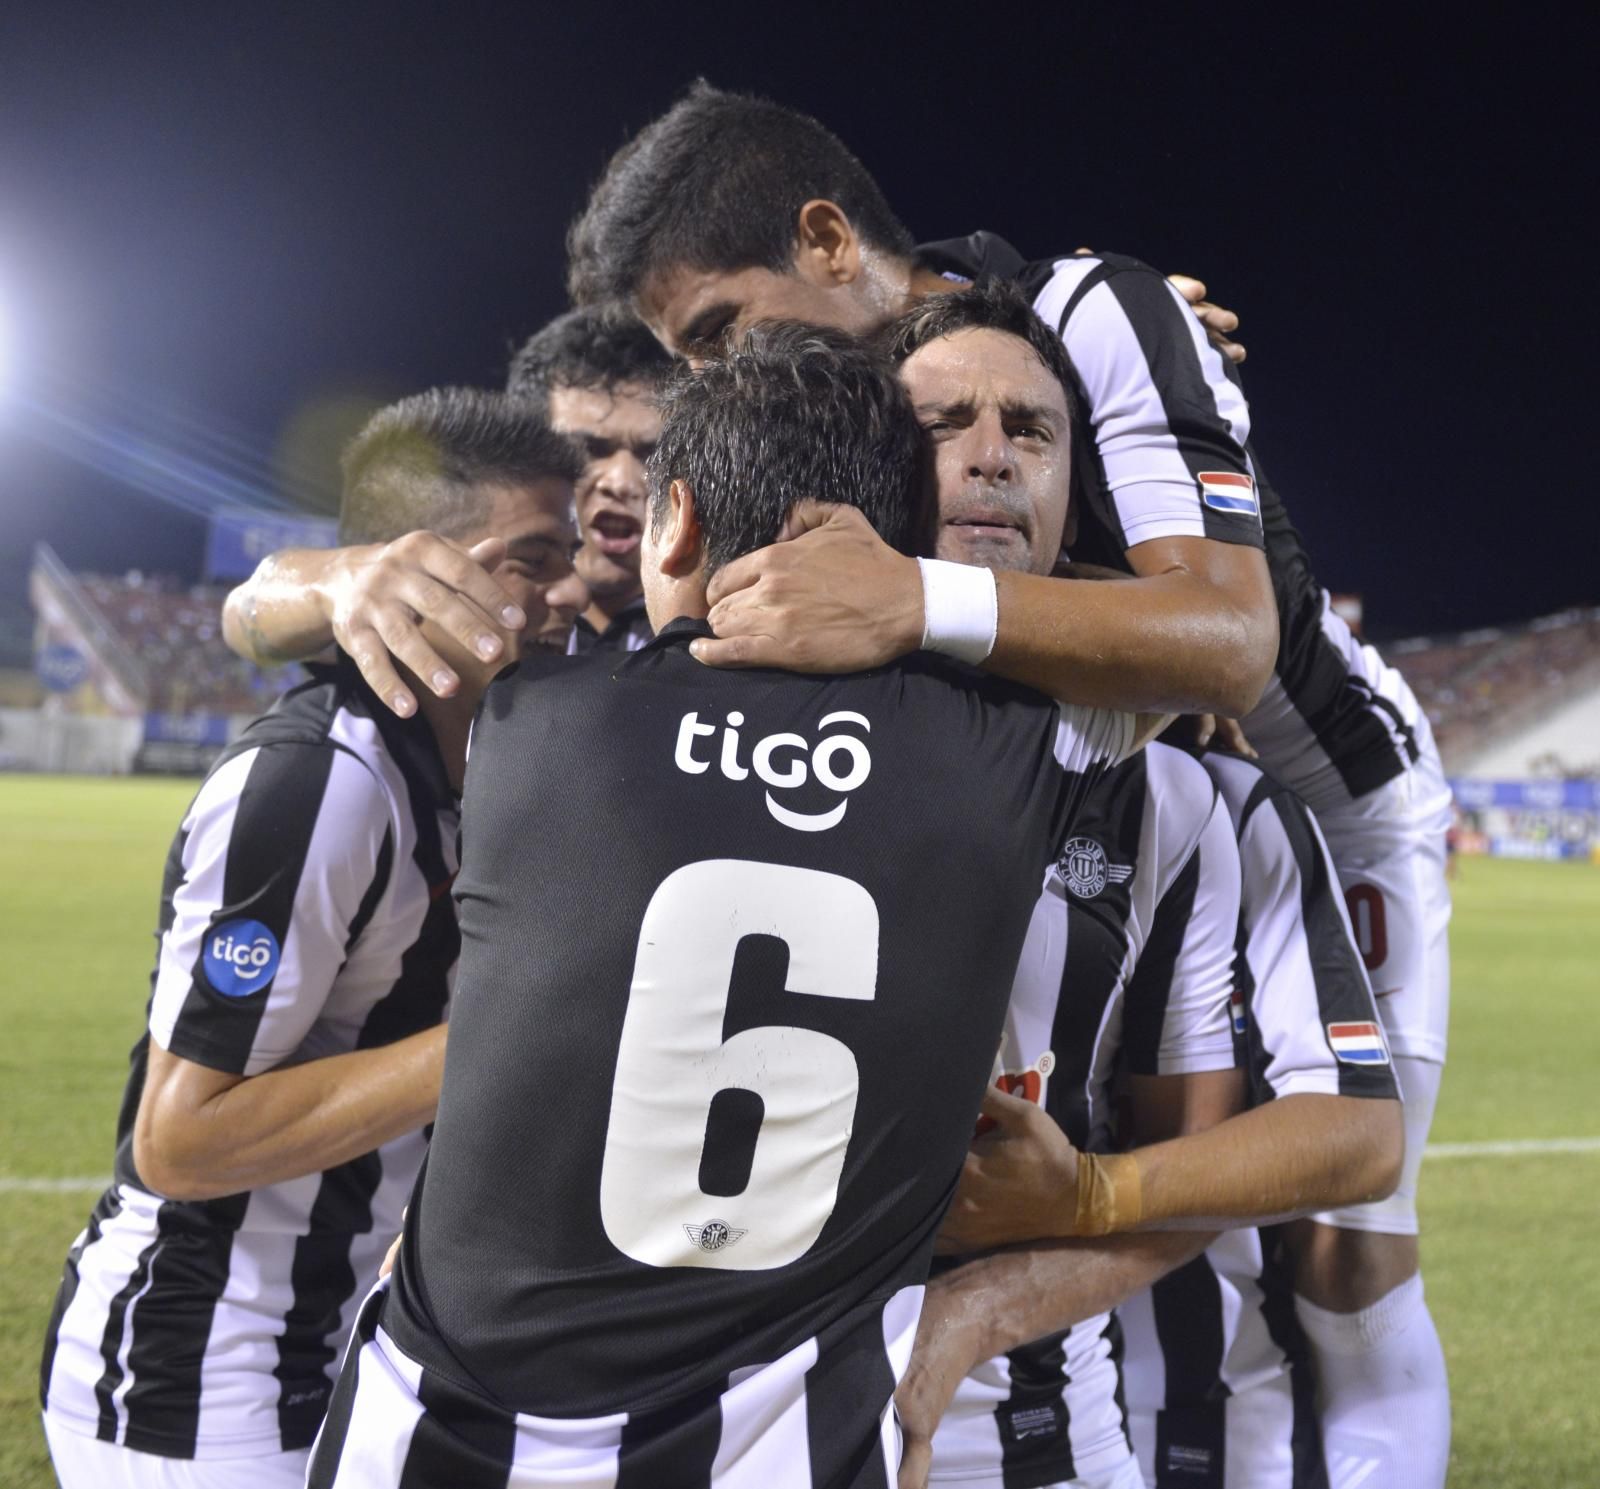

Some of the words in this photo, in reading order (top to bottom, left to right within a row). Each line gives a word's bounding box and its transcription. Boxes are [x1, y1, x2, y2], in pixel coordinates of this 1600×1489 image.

[1065, 840, 1103, 860] CLUB
[1061, 868, 1105, 896] LIBERTAD
[213, 936, 271, 979] tigo
[600, 858, 880, 1271] 6
